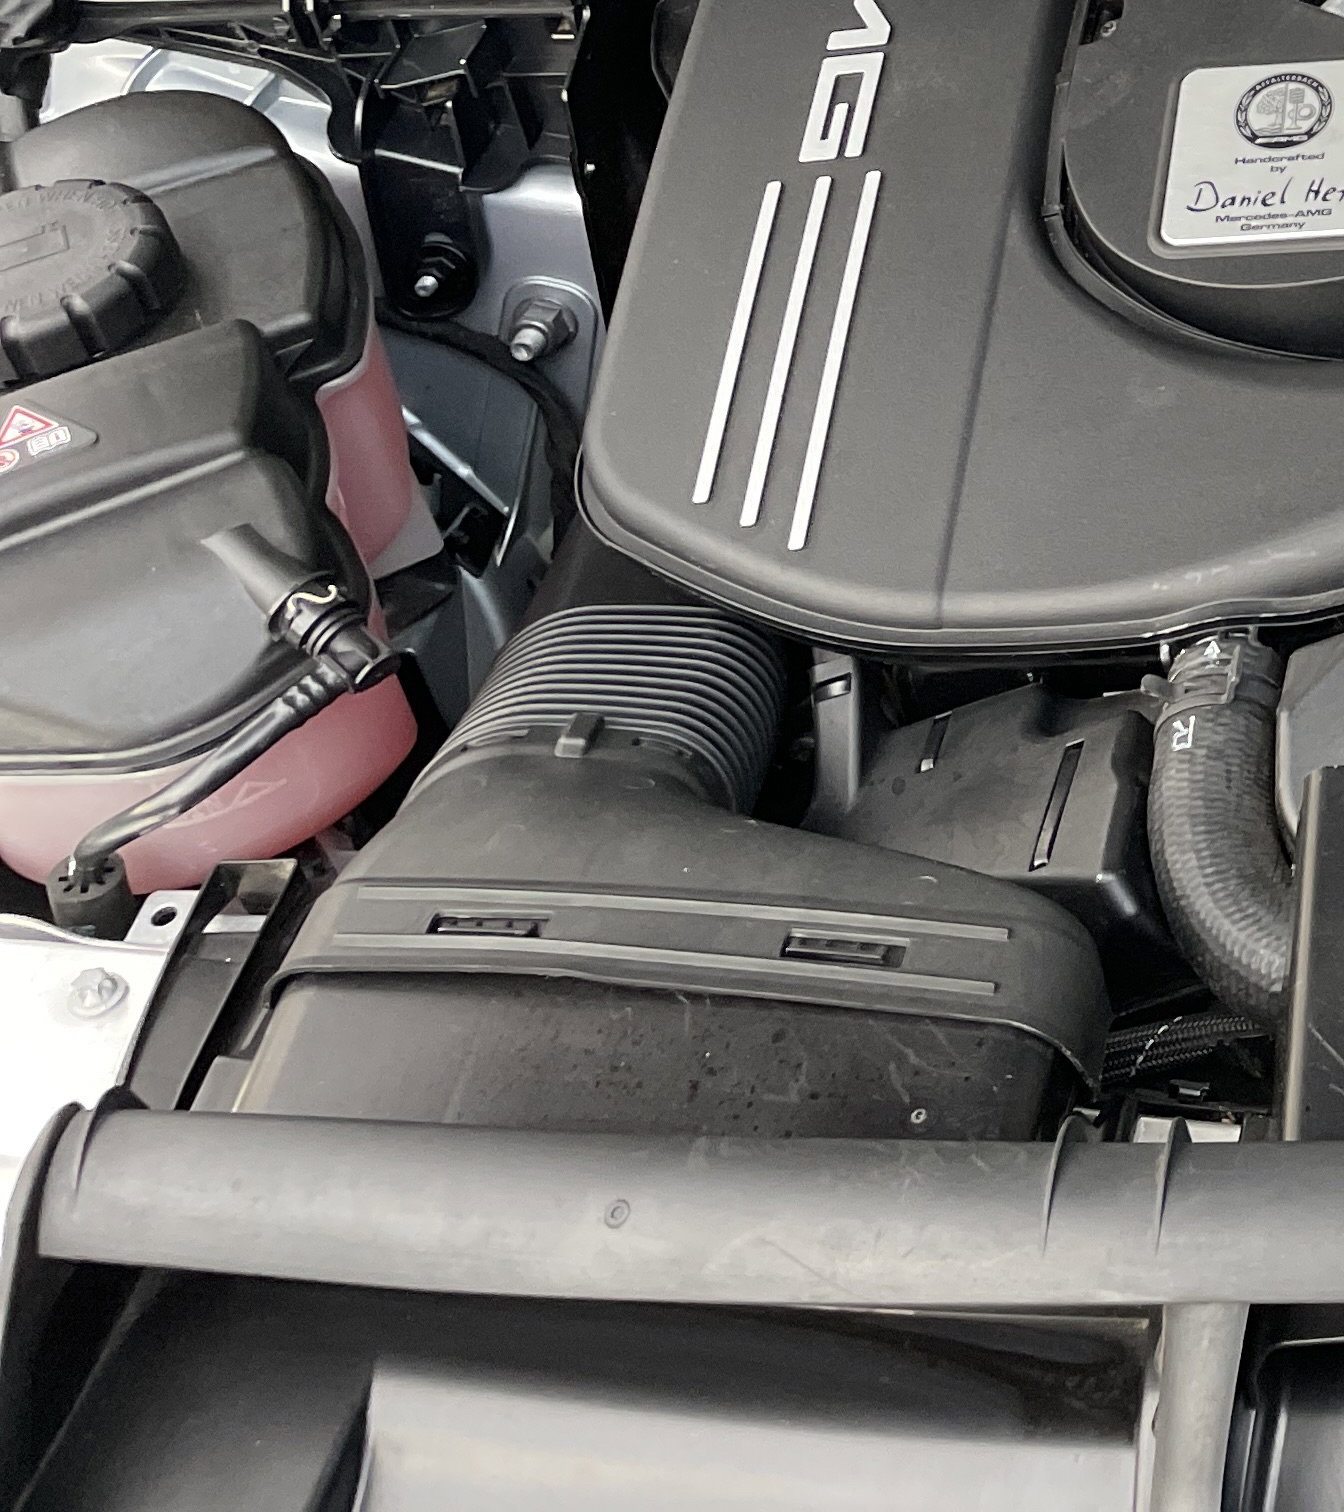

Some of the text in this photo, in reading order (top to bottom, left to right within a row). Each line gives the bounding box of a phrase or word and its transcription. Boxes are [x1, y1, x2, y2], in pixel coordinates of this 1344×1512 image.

[1234, 152, 1326, 165] Handcrafted
[1270, 165, 1287, 173] by
[1186, 176, 1293, 212] Daniel
[1215, 208, 1333, 223] Mercedes-AMG
[1240, 221, 1306, 231] Germany
